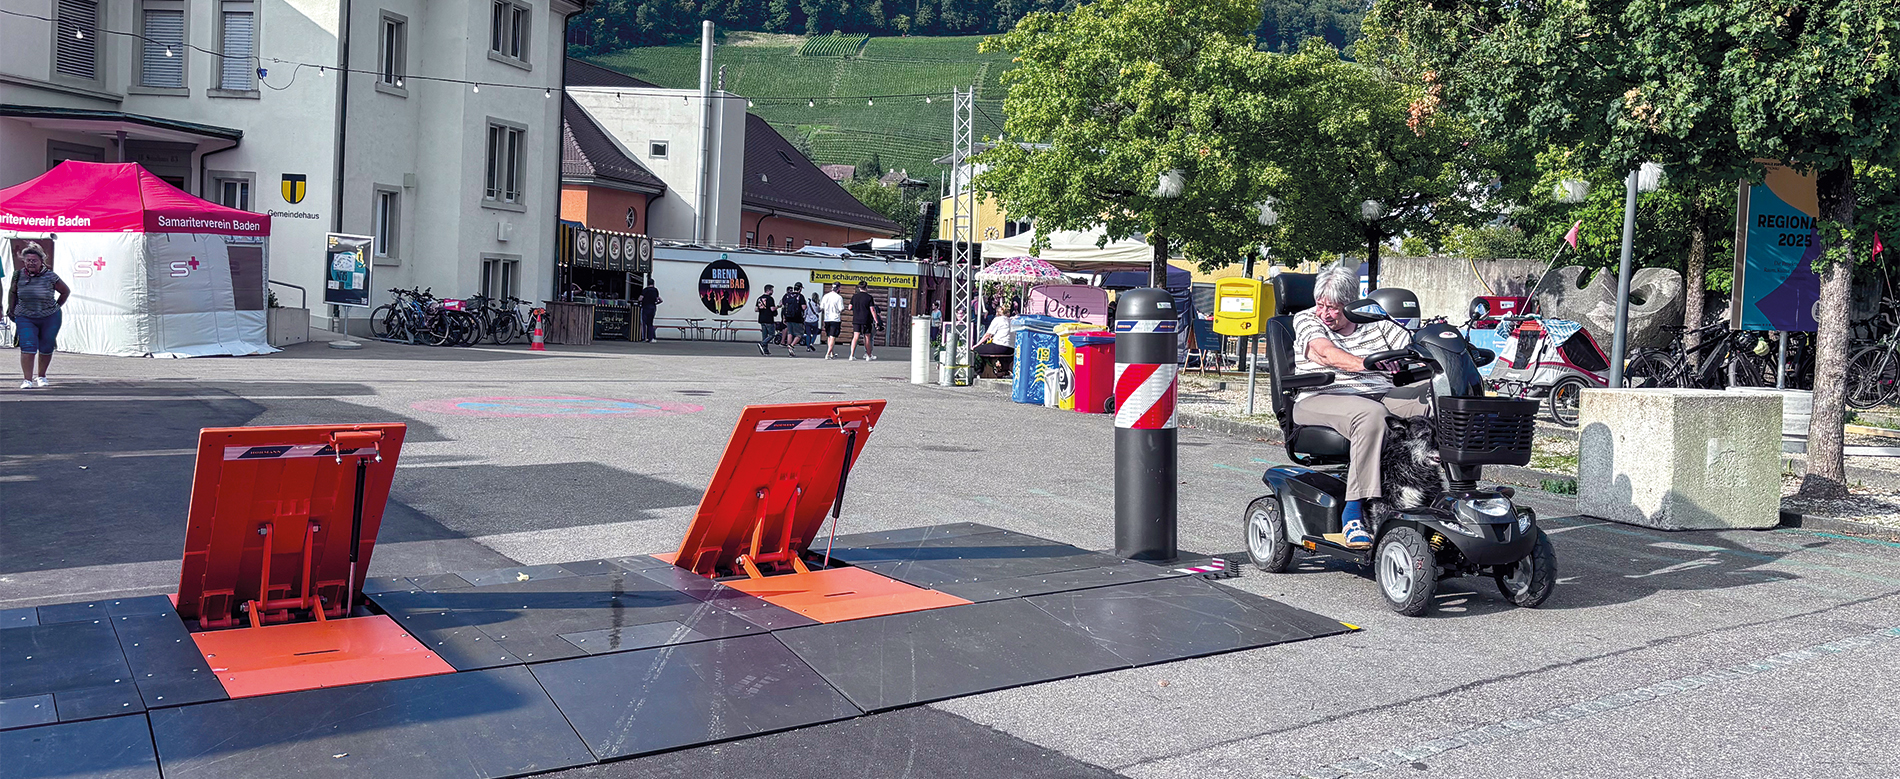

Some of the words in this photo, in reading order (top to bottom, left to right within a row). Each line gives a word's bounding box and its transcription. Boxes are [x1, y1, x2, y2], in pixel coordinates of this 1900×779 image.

[267, 209, 320, 220] Gemeindehaus
[57, 215, 91, 227] Baden
[158, 216, 231, 230] Samariterverein
[233, 220, 260, 231] Baden
[1778, 233, 1813, 247] 2025
[712, 268, 738, 279] BRENN
[729, 278, 745, 289] BAR
[883, 275, 911, 284] Hydrant
[1044, 297, 1091, 319] Petite
